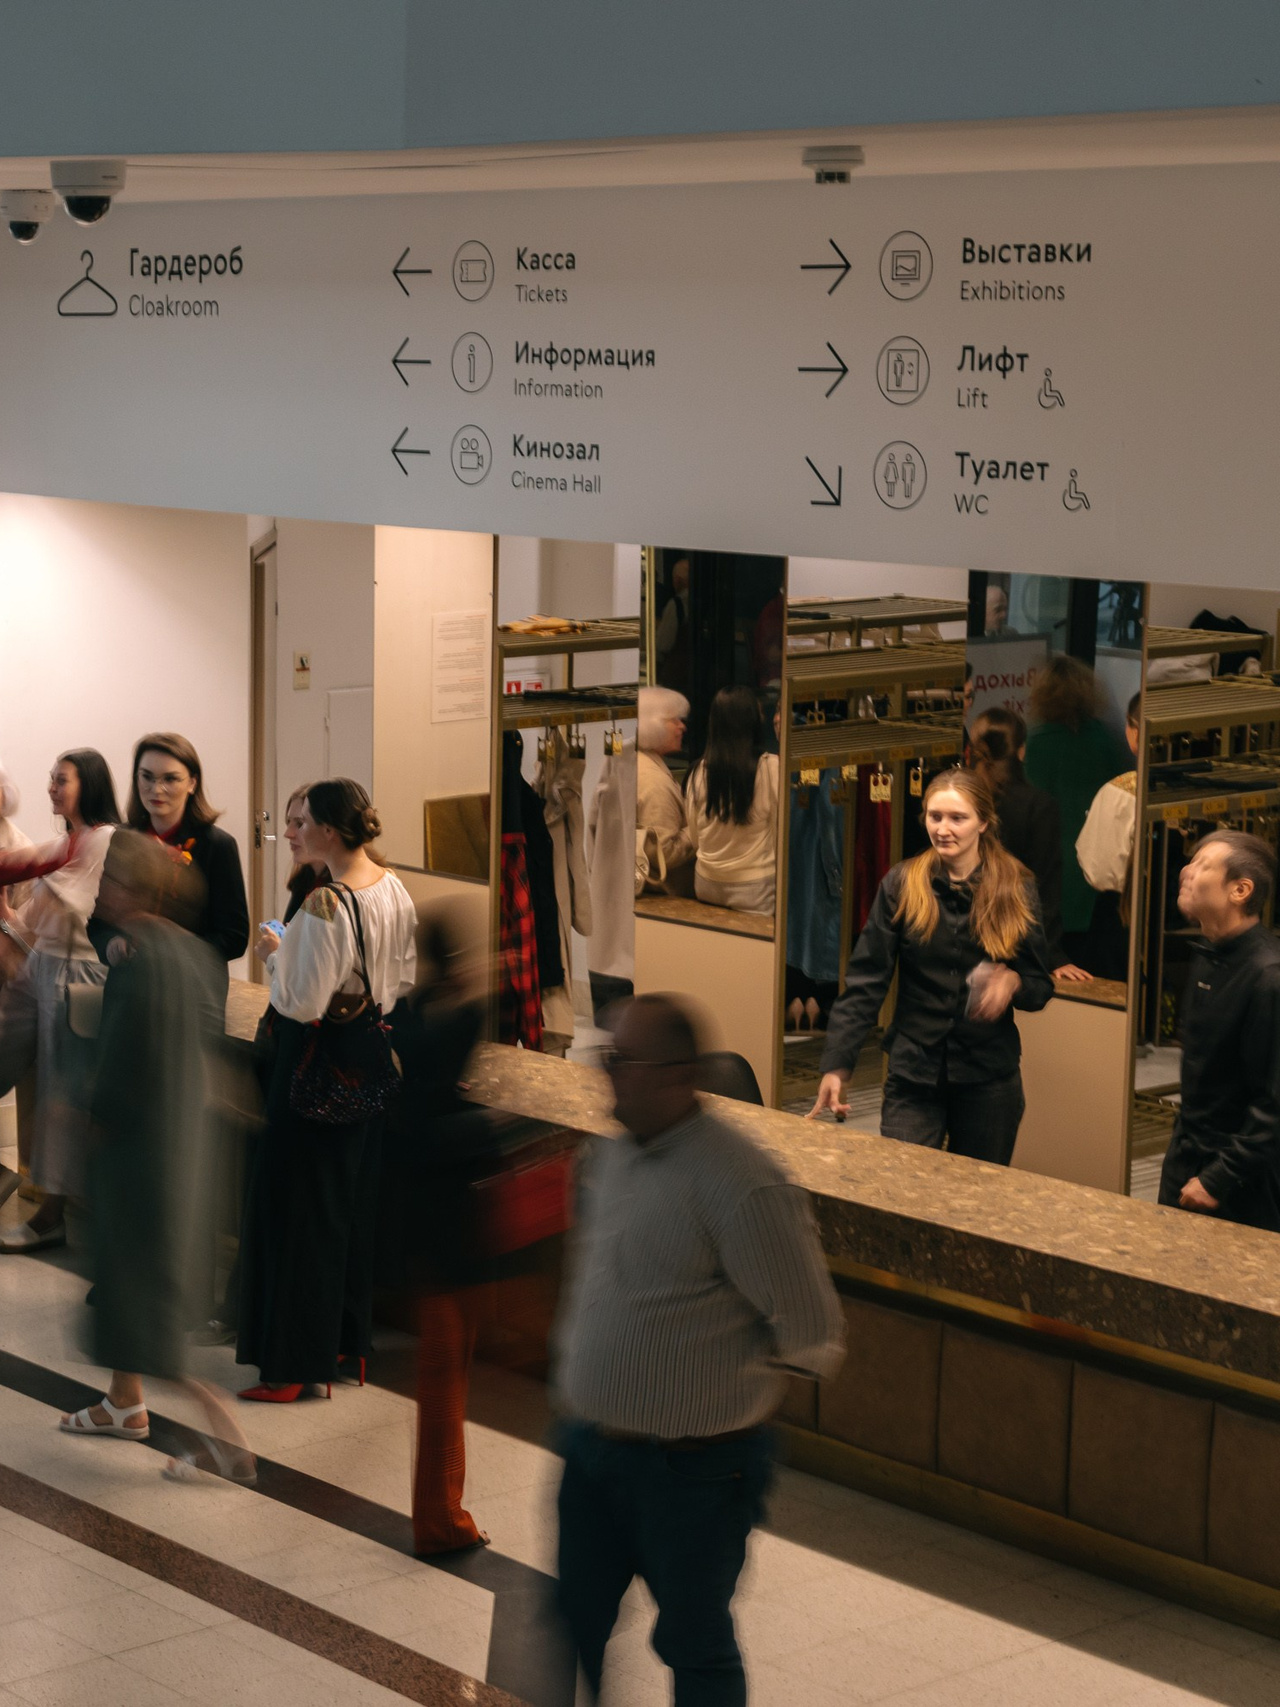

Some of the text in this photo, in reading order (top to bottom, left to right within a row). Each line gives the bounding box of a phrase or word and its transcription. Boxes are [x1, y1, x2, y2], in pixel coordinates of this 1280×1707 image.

[516, 246, 576, 271] Касса
[961, 237, 1092, 265] Выставки
[129, 245, 244, 285] Гардероб
[514, 283, 568, 303] Tickets
[959, 279, 1066, 302] Exhibitions
[128, 293, 220, 318] Cloakroom
[514, 340, 656, 372] Информация
[956, 344, 1030, 380] Лифт
[513, 377, 604, 399] Information
[956, 387, 989, 409] Lift
[511, 434, 600, 462] Кинозал
[954, 451, 1050, 486] Туалет
[510, 470, 602, 494] Cinema Hall
[953, 493, 990, 516] WC
